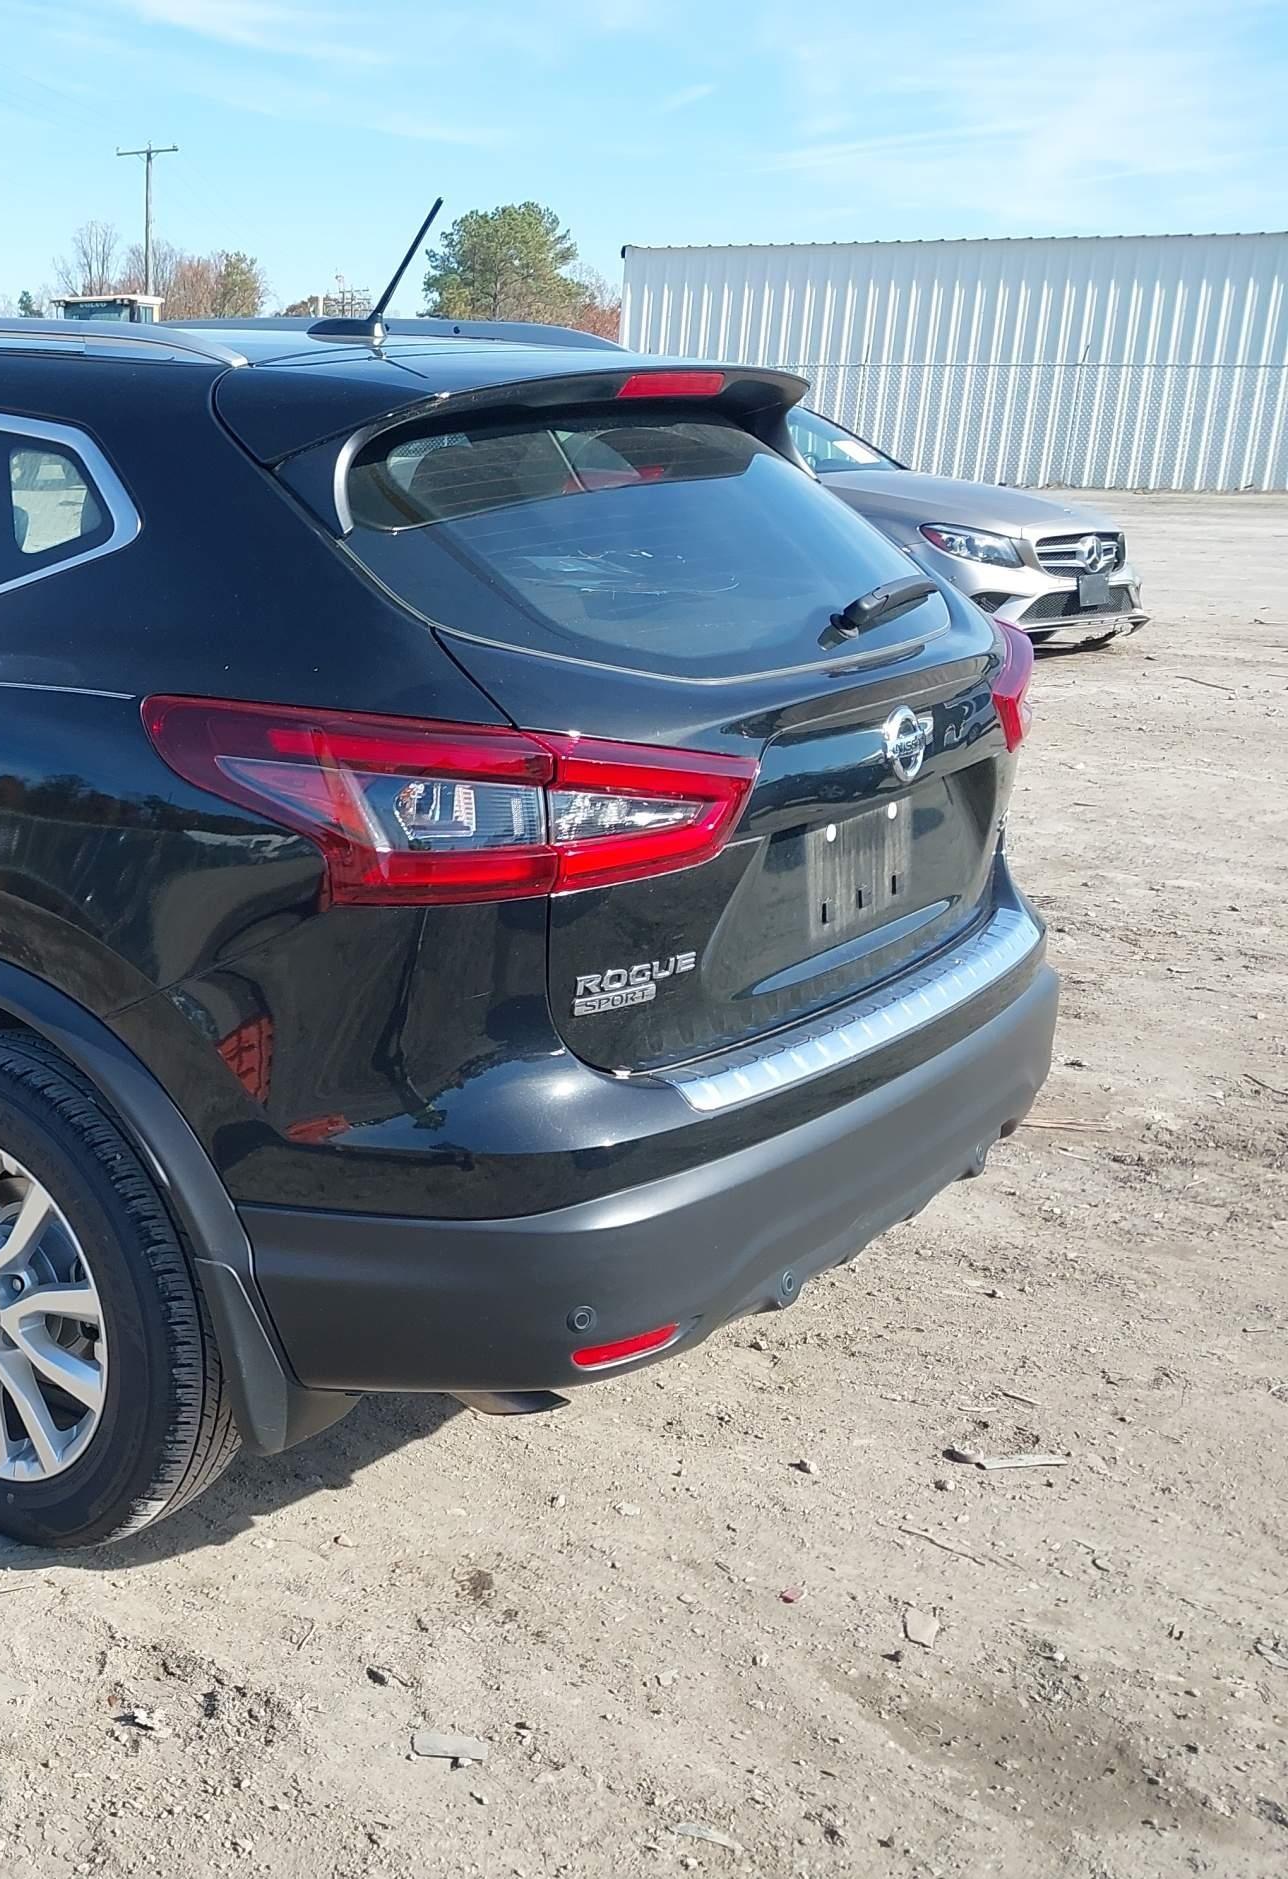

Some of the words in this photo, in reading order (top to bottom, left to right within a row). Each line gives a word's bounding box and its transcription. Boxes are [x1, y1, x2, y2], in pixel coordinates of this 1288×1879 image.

[895, 734, 925, 753] NISS
[576, 951, 697, 996] ROGUE
[583, 989, 650, 1013] SPORT
